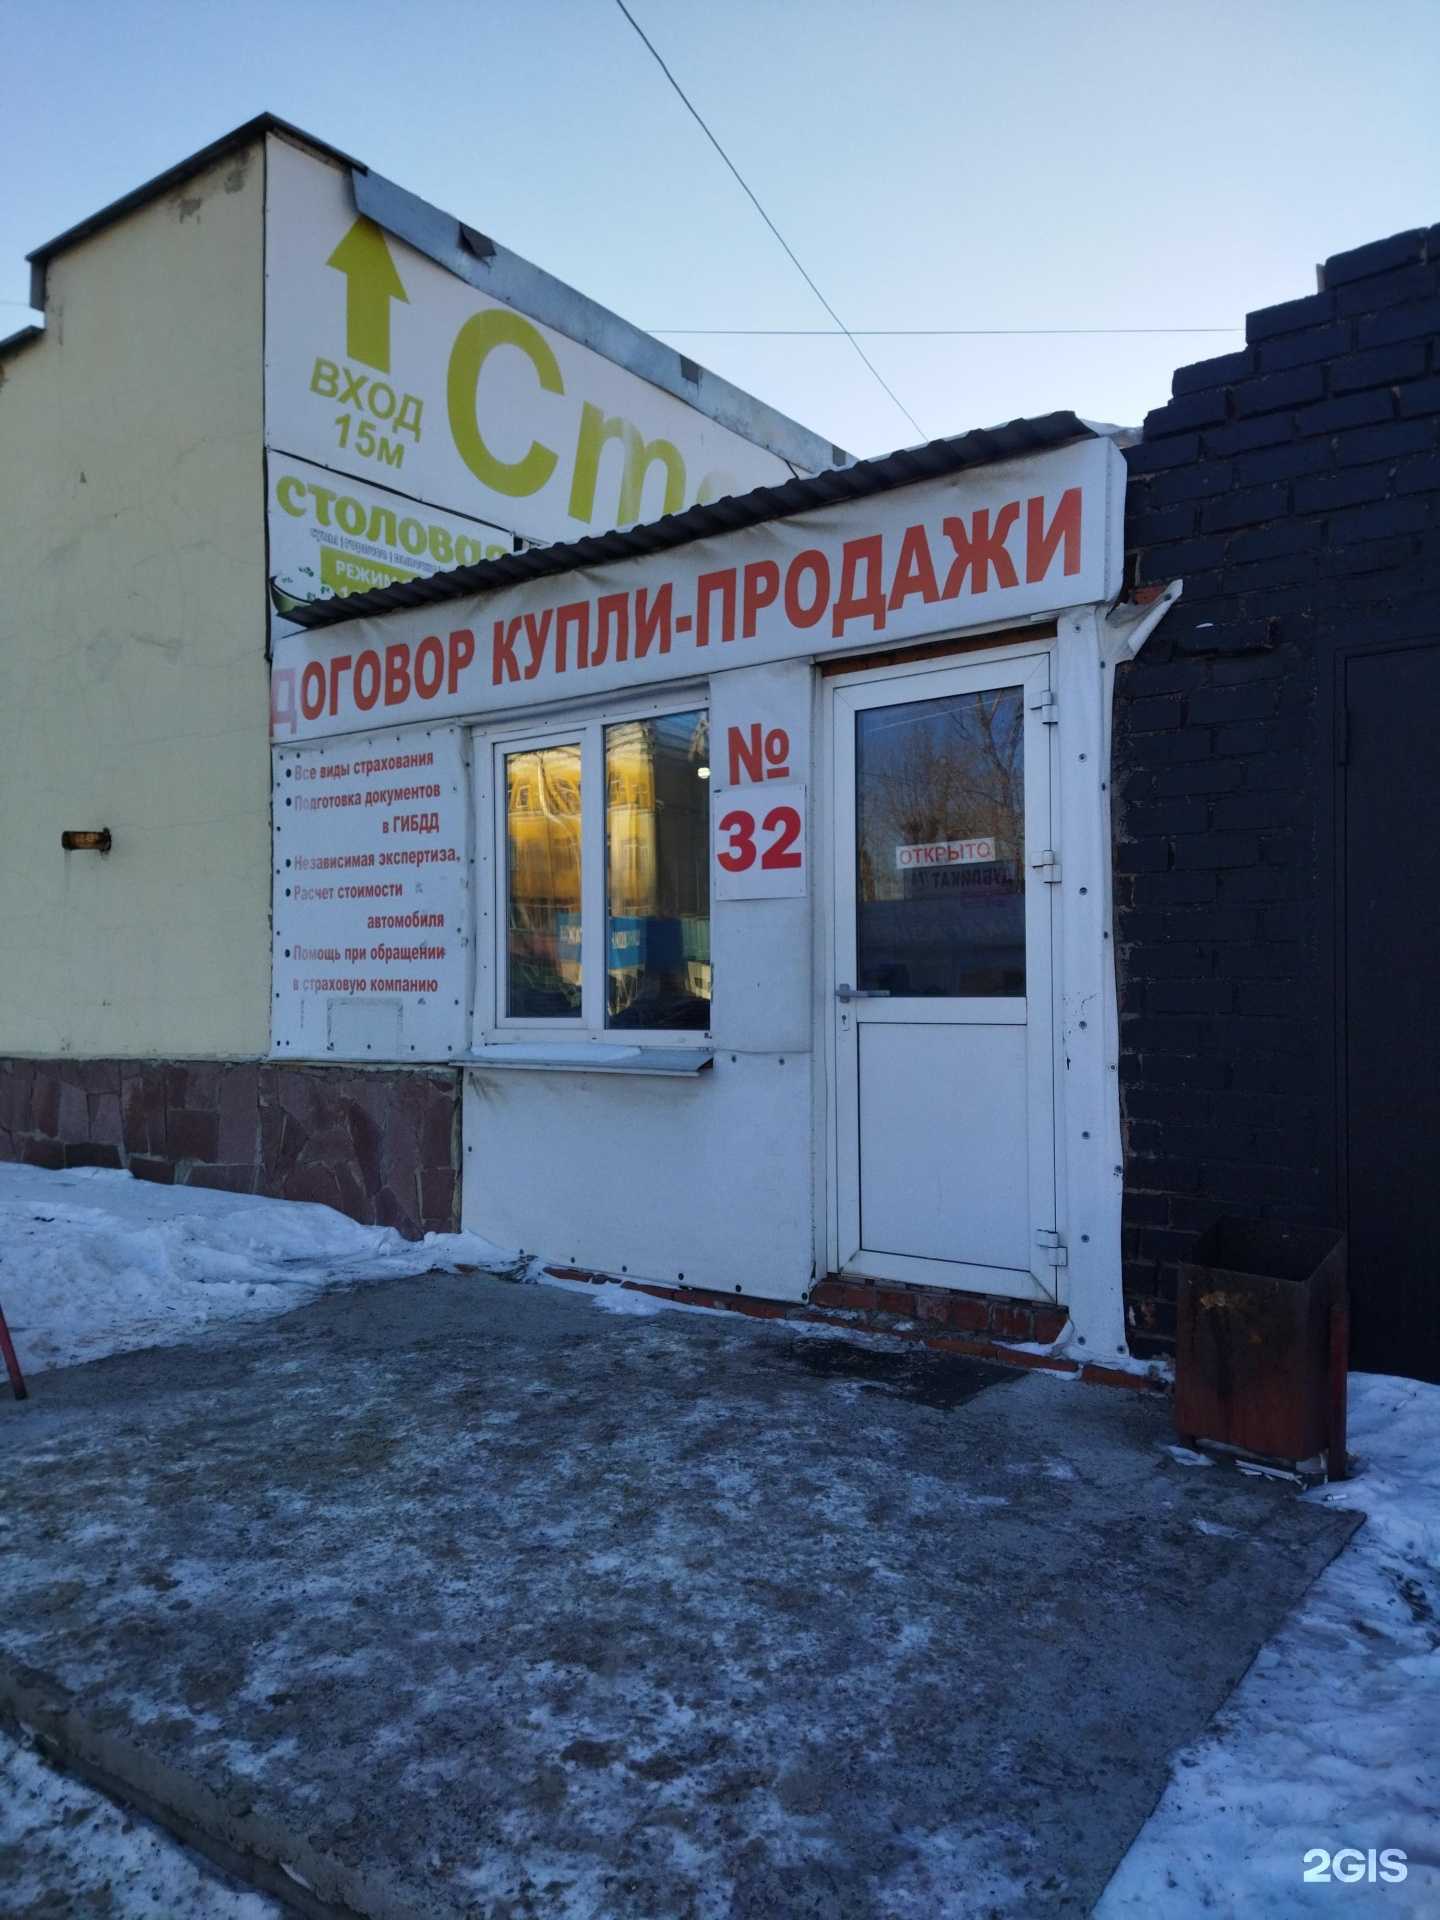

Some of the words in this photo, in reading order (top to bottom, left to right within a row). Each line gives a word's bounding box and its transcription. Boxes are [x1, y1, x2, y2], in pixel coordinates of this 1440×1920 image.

[310, 358, 424, 442] ВХОД
[269, 632, 475, 738] ДОГОВОР
[492, 487, 1083, 686] КУПЛИ-ПРОДАЖИ
[295, 764, 316, 780] Все
[320, 762, 350, 779] виды
[354, 751, 433, 776] страхования
[295, 792, 361, 812] Подготовка
[365, 782, 441, 808] документов
[393, 813, 439, 834] ГИБДД
[717, 806, 802, 872] 32
[295, 852, 374, 871] Независимая
[899, 842, 991, 864] ОТКРЫТО
[295, 885, 334, 900] Расчет
[338, 883, 403, 898] стоимости
[367, 912, 444, 928] автомобиля
[293, 945, 340, 962] Помощь
[345, 946, 366, 963] при
[370, 943, 445, 962] обращении
[303, 978, 367, 995] страховую
[370, 978, 437, 993] компанию
